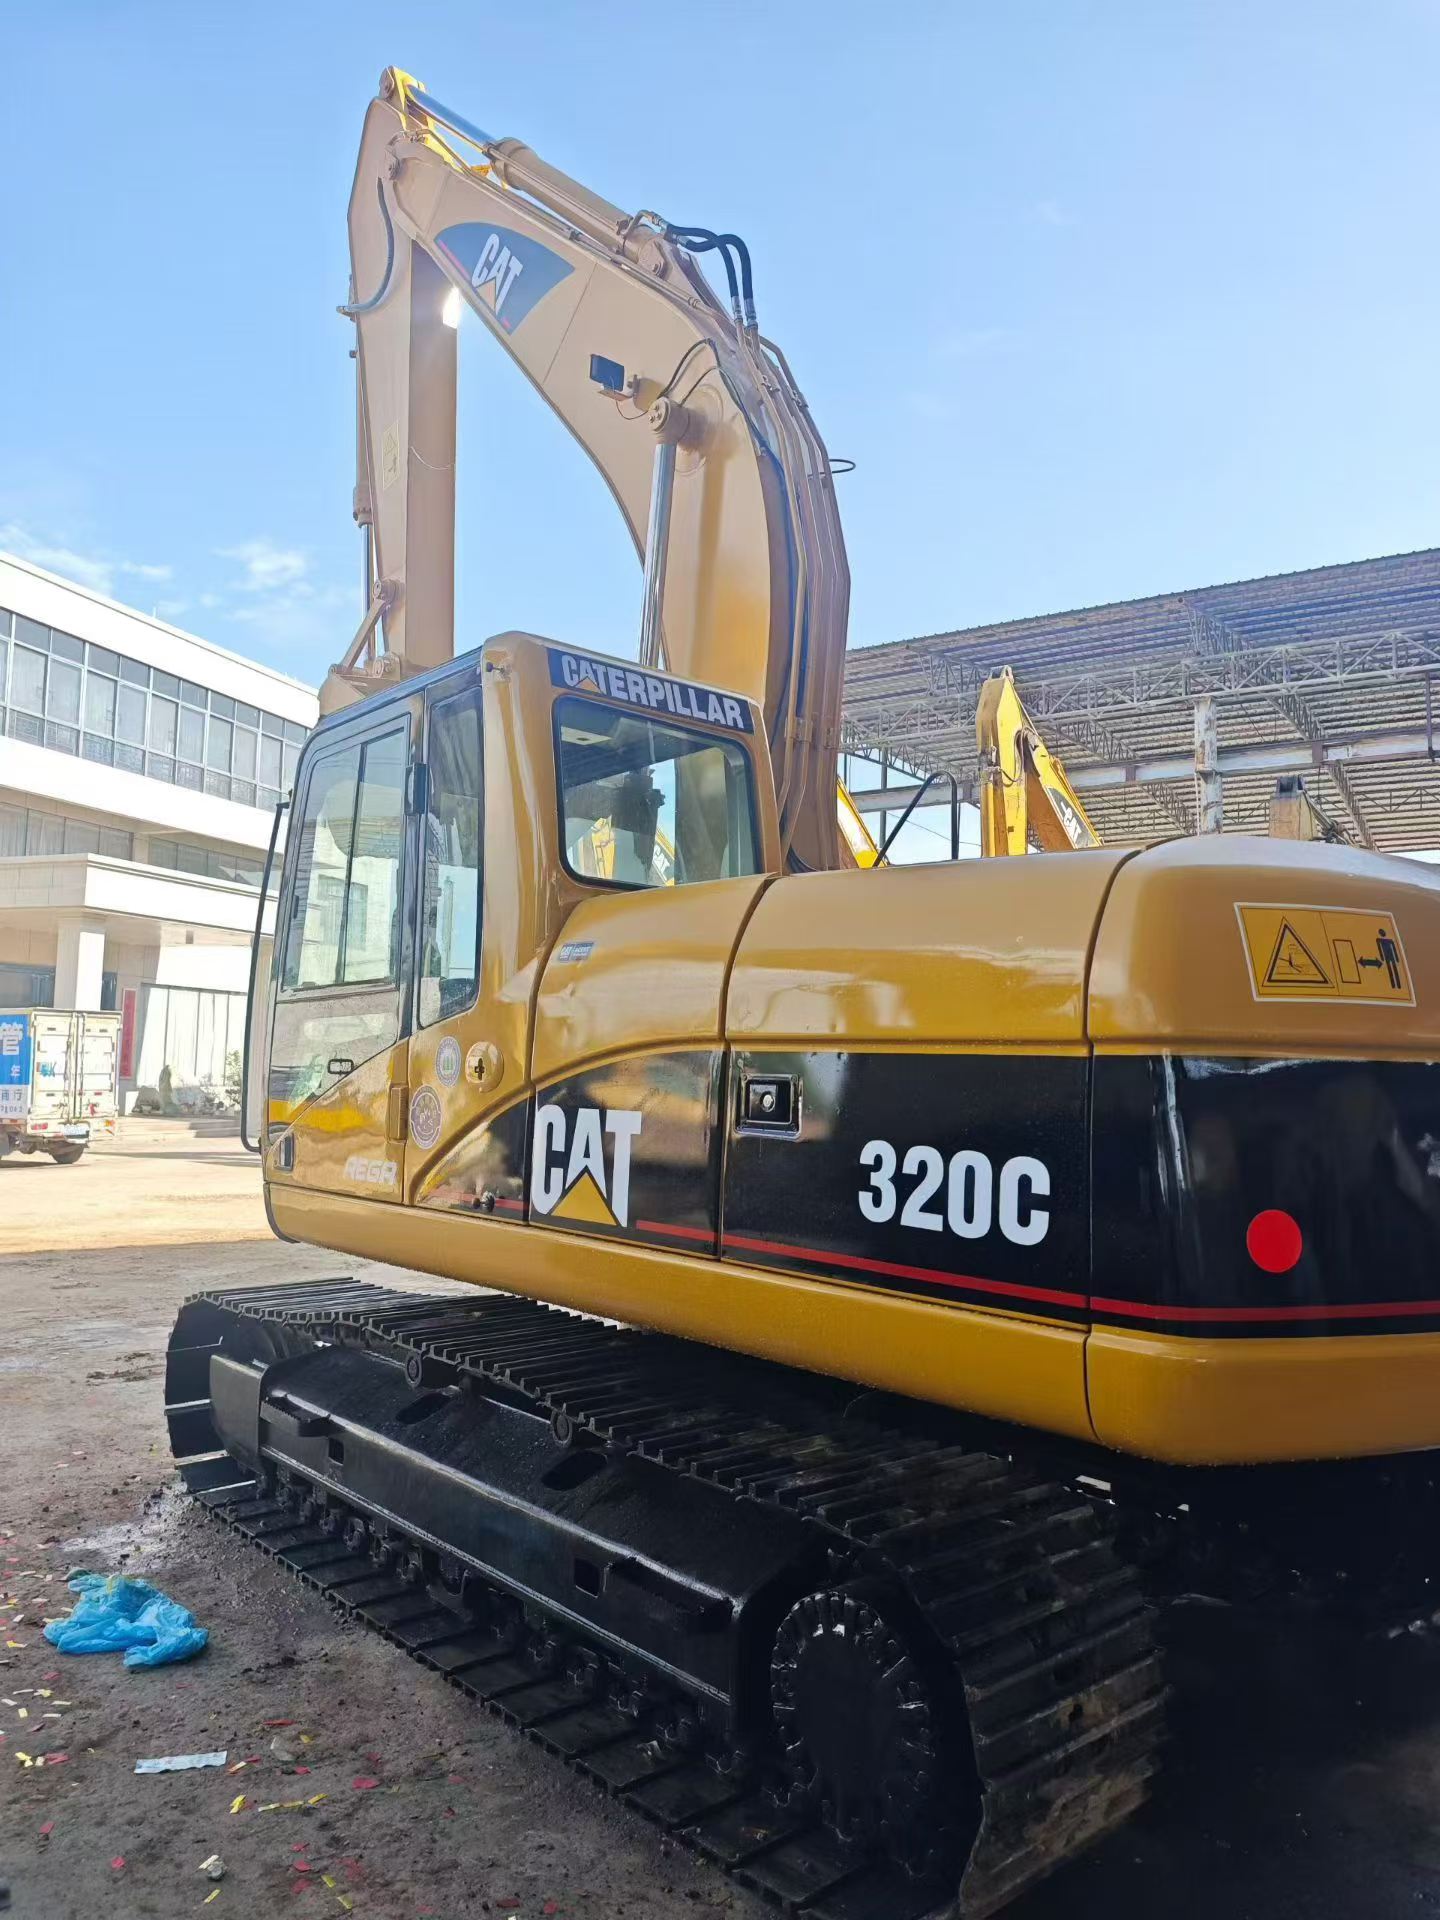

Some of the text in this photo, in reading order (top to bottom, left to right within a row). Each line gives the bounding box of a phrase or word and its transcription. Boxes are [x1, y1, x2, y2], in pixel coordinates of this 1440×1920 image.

[471, 233, 523, 315] CAT
[562, 654, 744, 729] CATERPILLAR
[531, 1104, 641, 1227] CAT
[858, 1140, 1051, 1246] 320C
